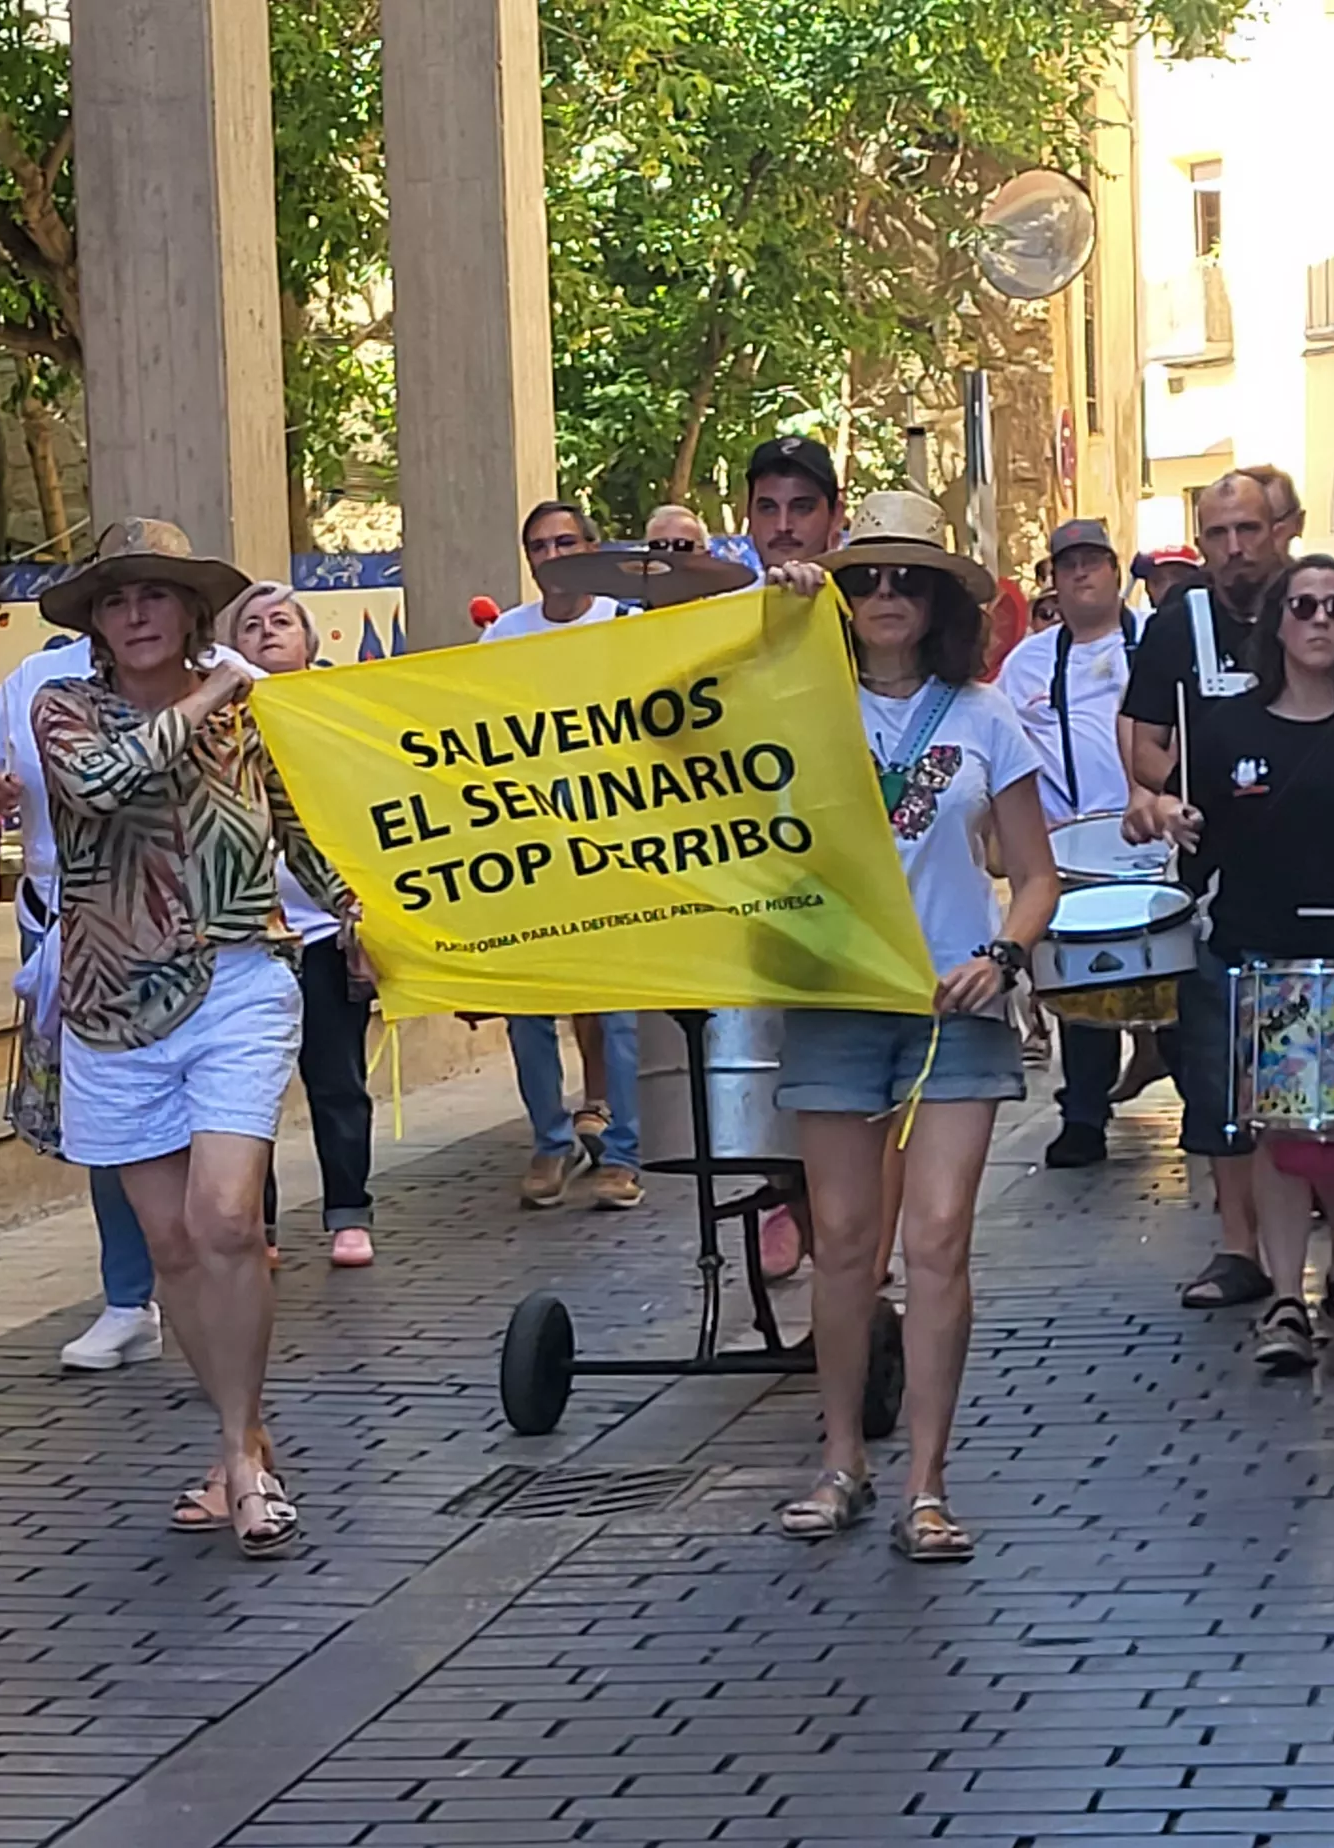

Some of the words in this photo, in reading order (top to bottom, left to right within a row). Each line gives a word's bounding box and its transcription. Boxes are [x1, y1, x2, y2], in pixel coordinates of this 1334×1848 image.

[400, 676, 724, 769] SALVEMOS
[371, 794, 451, 851] EL
[462, 743, 796, 829] SEMINARIO
[394, 842, 552, 911] STOP
[569, 816, 813, 877] DERRIBO
[522, 924, 559, 943] PARA
[562, 922, 580, 936] LA
[582, 911, 641, 933] DEFENSA
[643, 907, 668, 923] DEL
[742, 901, 761, 916] DE
[766, 894, 826, 912] HUESCA
